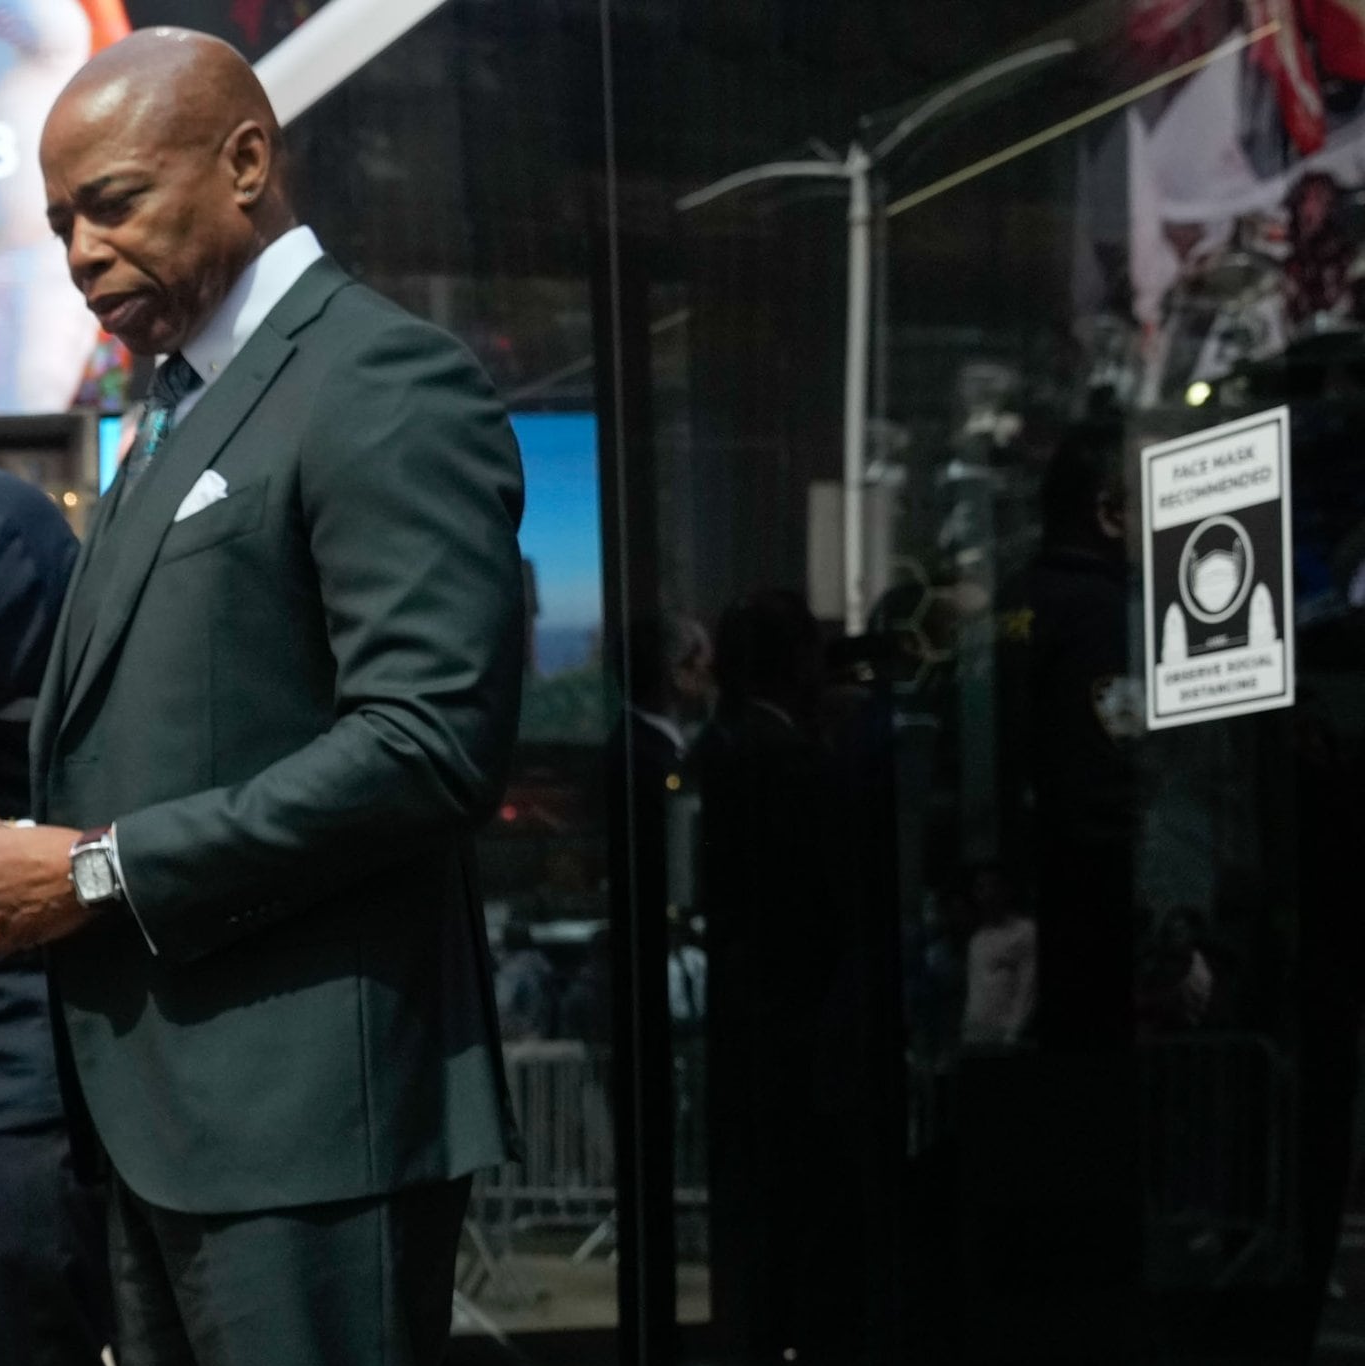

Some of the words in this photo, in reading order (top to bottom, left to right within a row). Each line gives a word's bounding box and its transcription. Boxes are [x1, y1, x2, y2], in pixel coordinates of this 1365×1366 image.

[1173, 457, 1208, 481] FACE
[1212, 444, 1255, 468] MASK
[1159, 466, 1272, 509] RECOMMENDED
